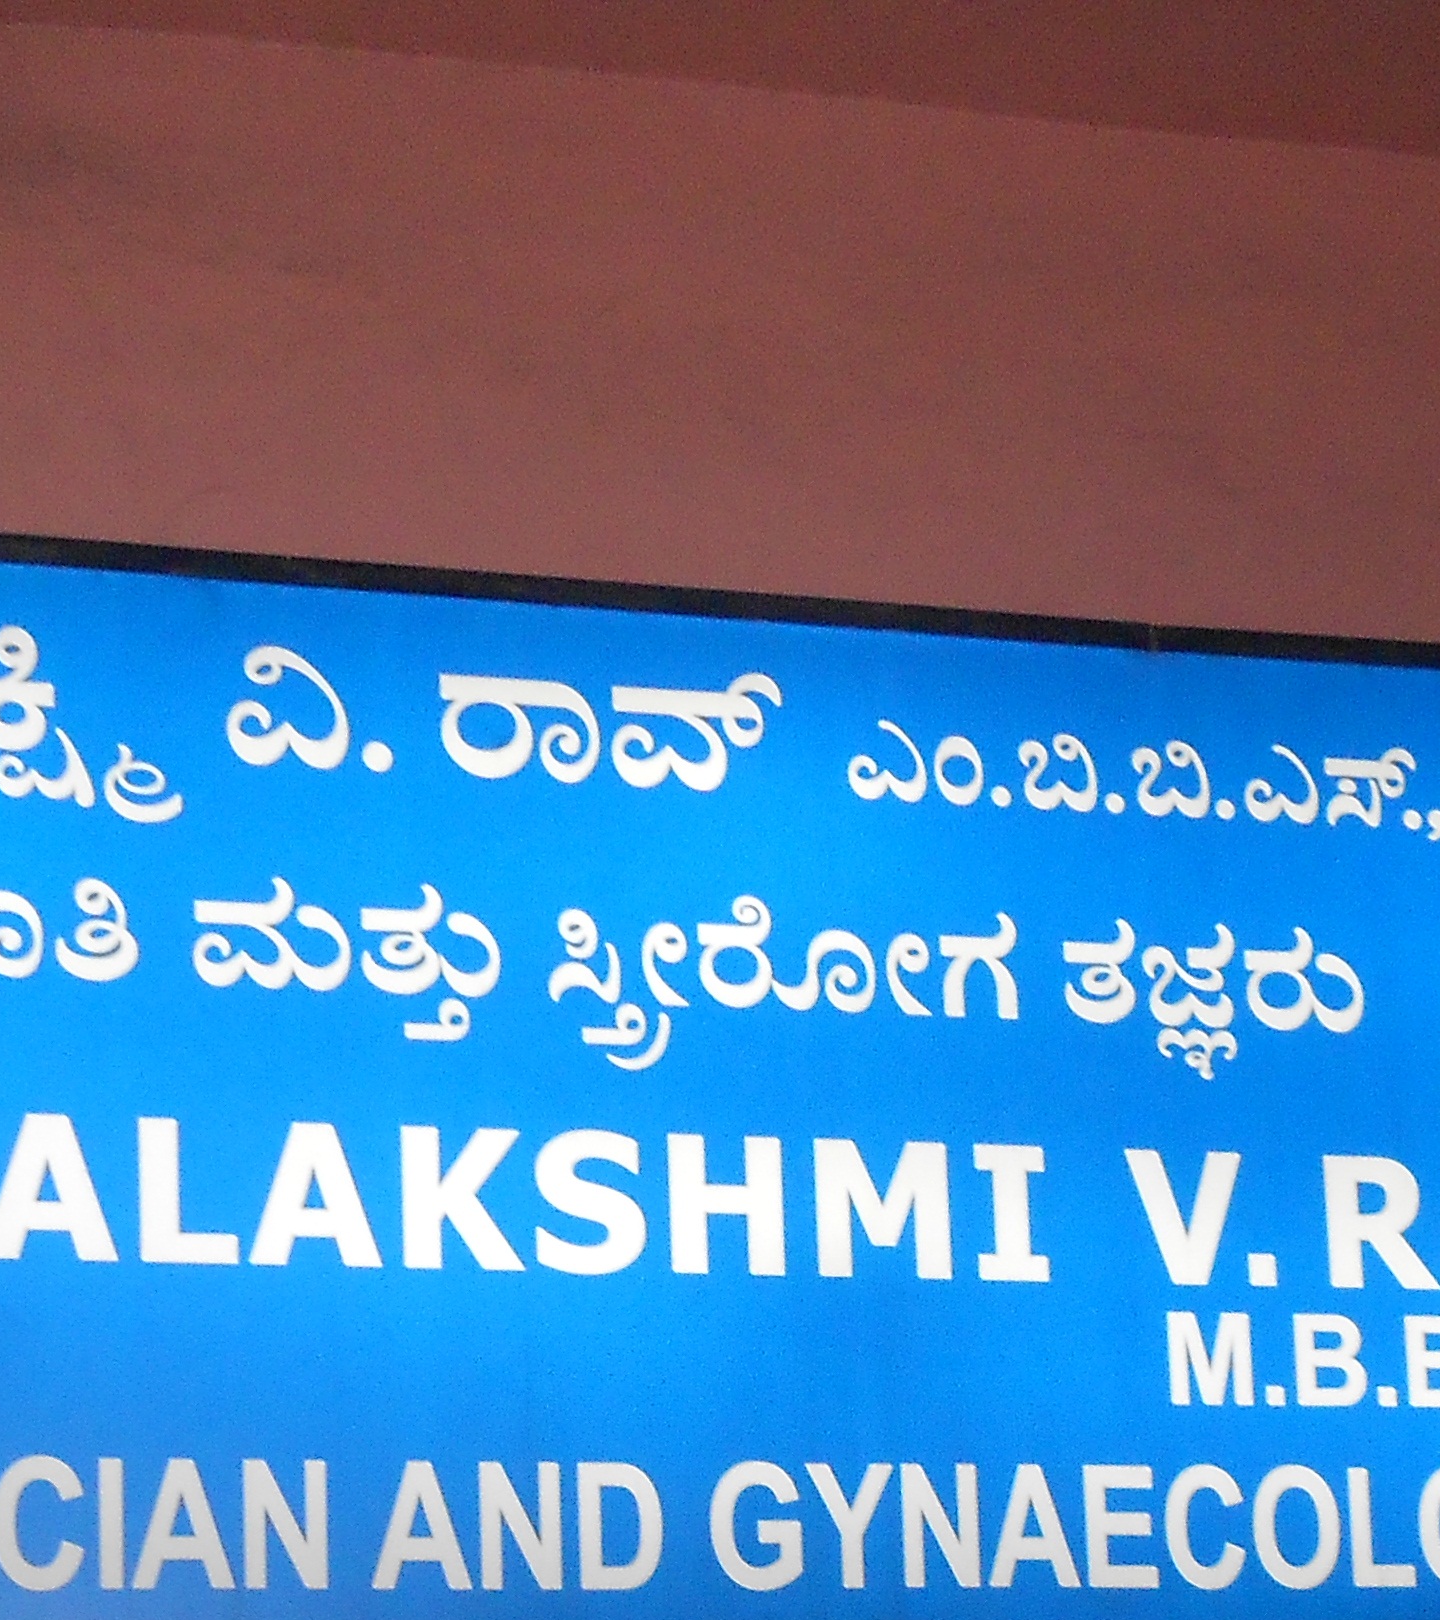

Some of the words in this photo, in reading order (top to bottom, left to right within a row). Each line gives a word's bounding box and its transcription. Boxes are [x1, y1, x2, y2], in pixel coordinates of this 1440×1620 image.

[224, 643, 395, 774] ವಿ.
[437, 670, 784, 794] ರಾವ್
[190, 874, 504, 1044] ಮತ್ತು
[546, 892, 1021, 1073] ಸ್ತ್ರೀರೋಗ
[1060, 916, 1367, 1083] ತಜ್ಞರು
[1122, 1146, 1280, 1289] V.
[369, 1458, 666, 1593] AND
